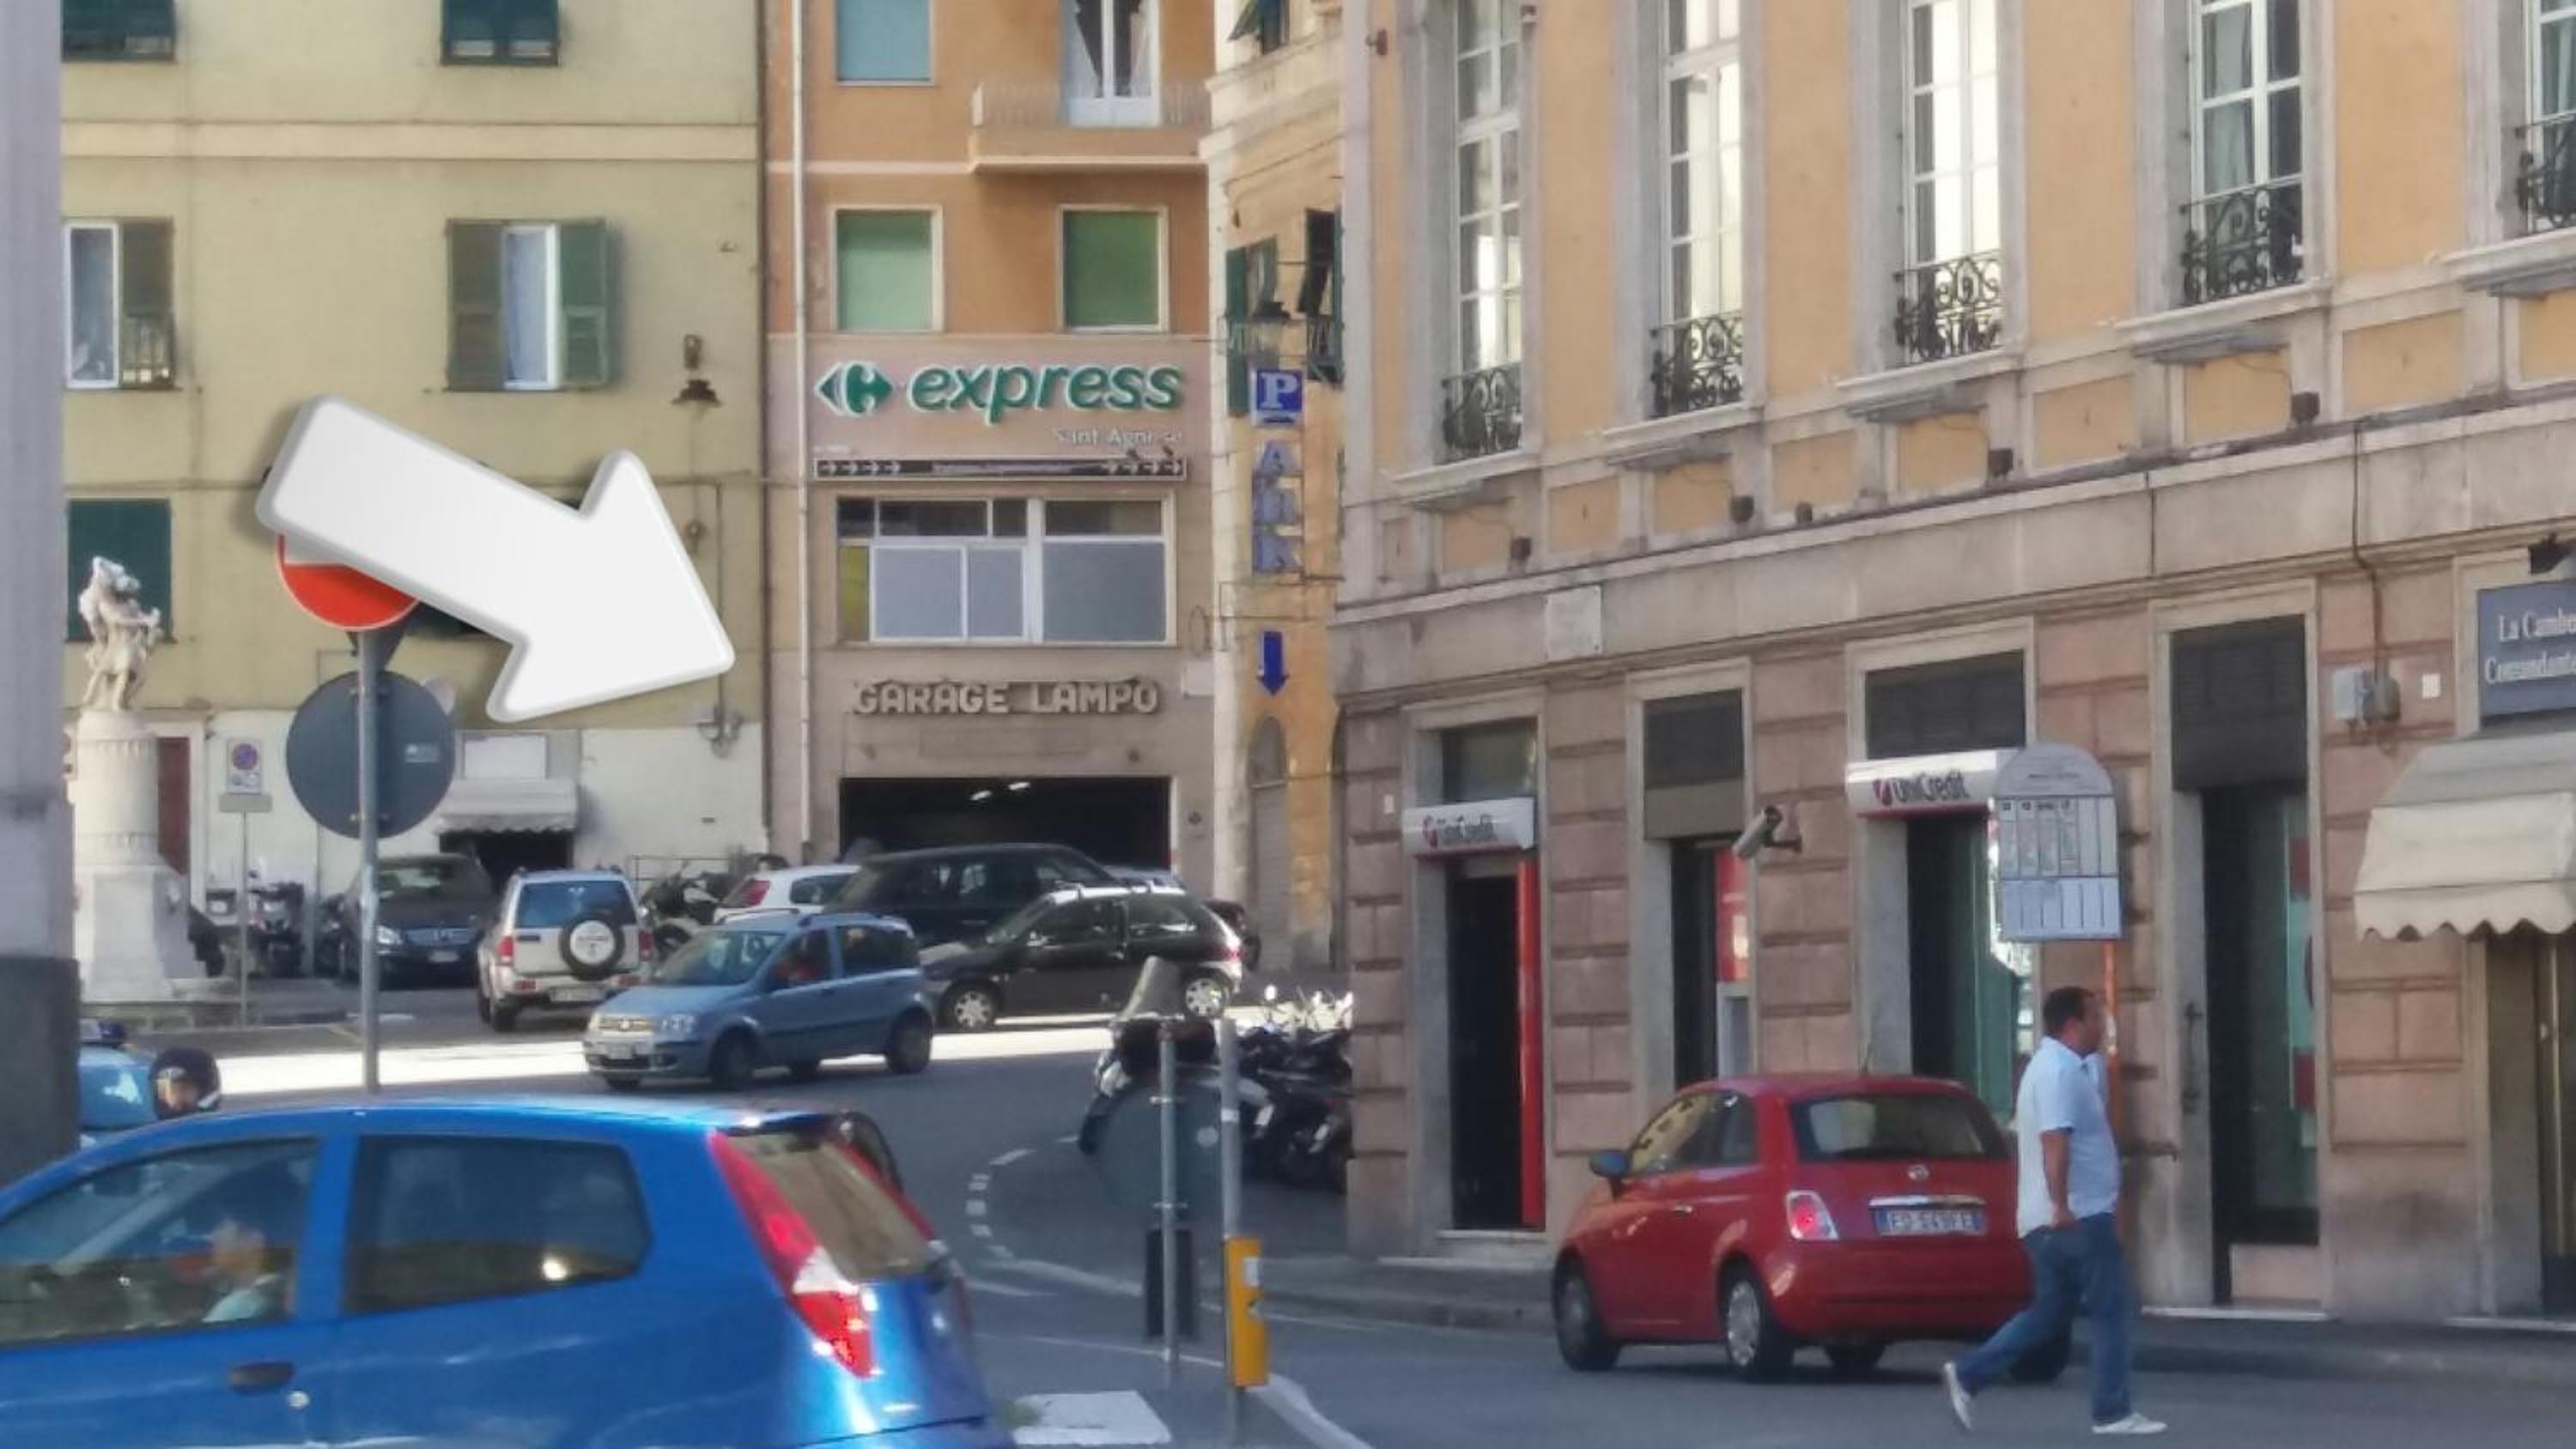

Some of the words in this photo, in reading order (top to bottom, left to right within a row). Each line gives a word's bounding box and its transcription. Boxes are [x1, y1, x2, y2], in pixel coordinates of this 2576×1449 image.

[908, 364, 1184, 426] express
[1260, 371, 1299, 409] P
[2500, 615, 2520, 642] La
[855, 684, 1010, 714] GARAGE
[1031, 684, 1158, 714] LAMPO
